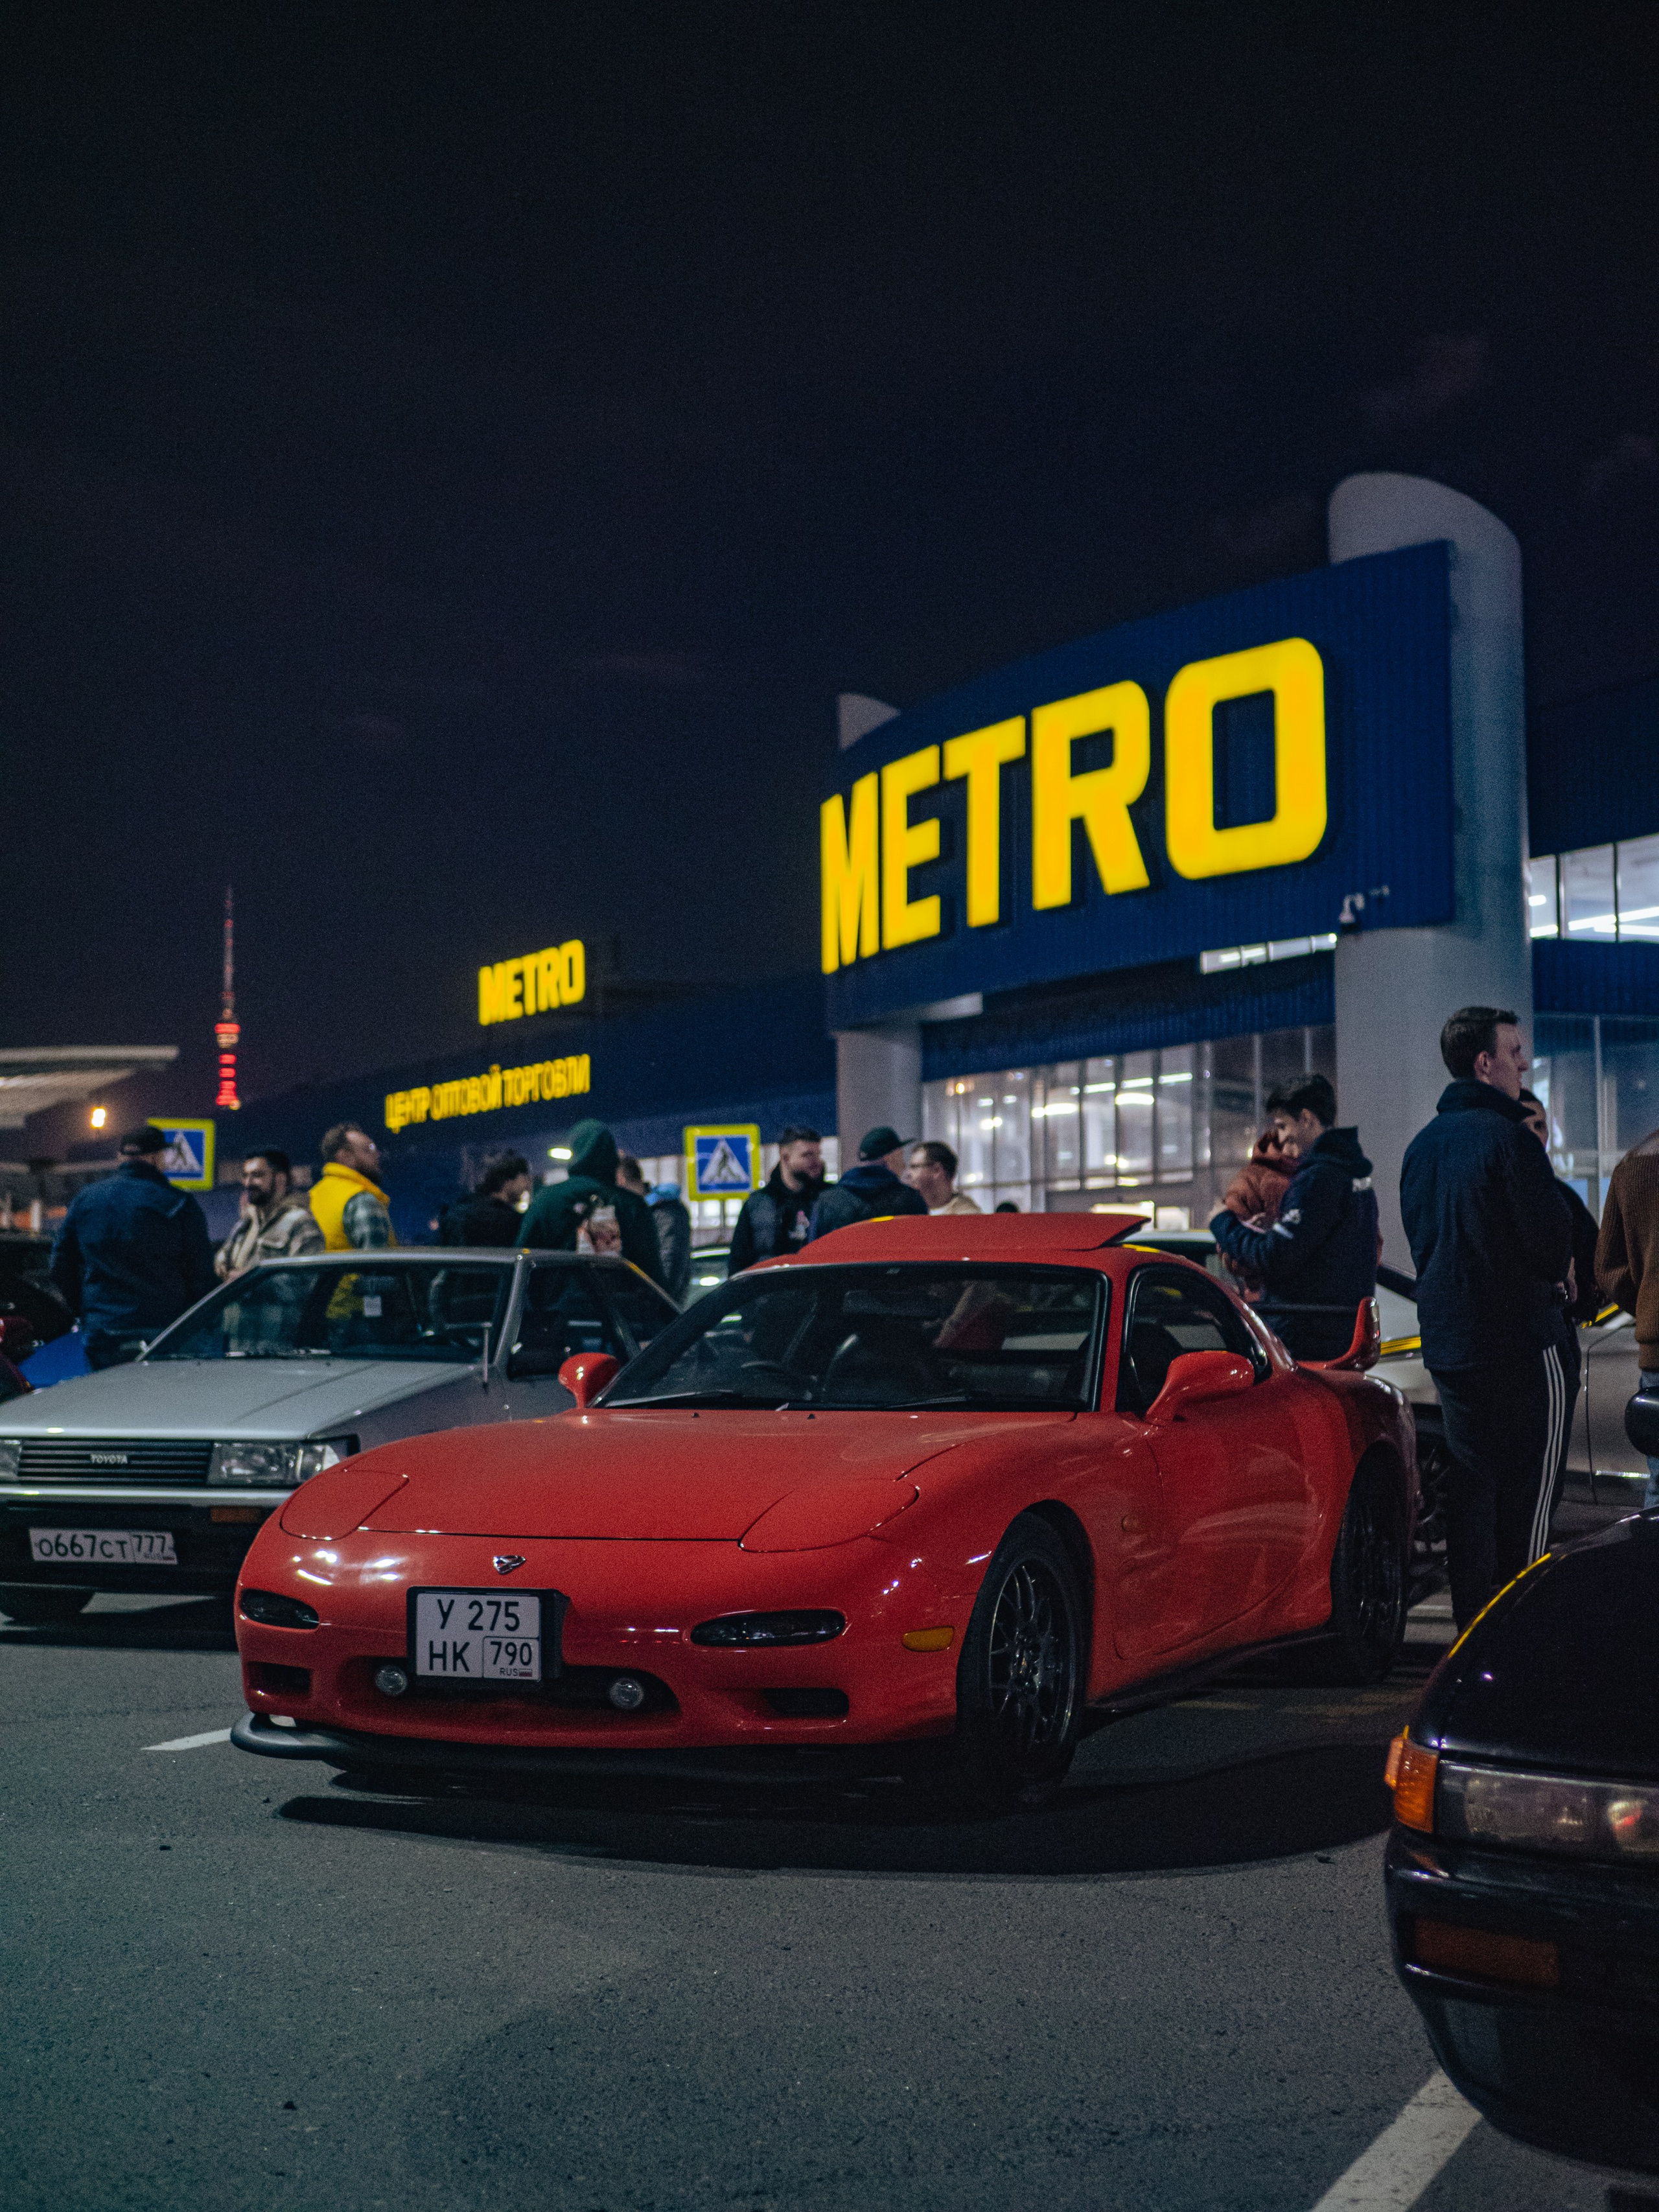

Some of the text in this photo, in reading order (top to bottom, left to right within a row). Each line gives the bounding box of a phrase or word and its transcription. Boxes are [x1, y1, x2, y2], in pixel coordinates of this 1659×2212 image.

[821, 638, 1331, 974] METRO
[478, 939, 585, 1026] METRO
[386, 1053, 590, 1134] ЦЕНТР ОПТОВОЙ ТОРГОВЛИ
[89, 1454, 128, 1465] TOYOTA
[132, 1534, 166, 1554] 777
[468, 1600, 520, 1632] 275
[428, 1640, 533, 1672] НК 790
[500, 1668, 518, 1677] RUS
